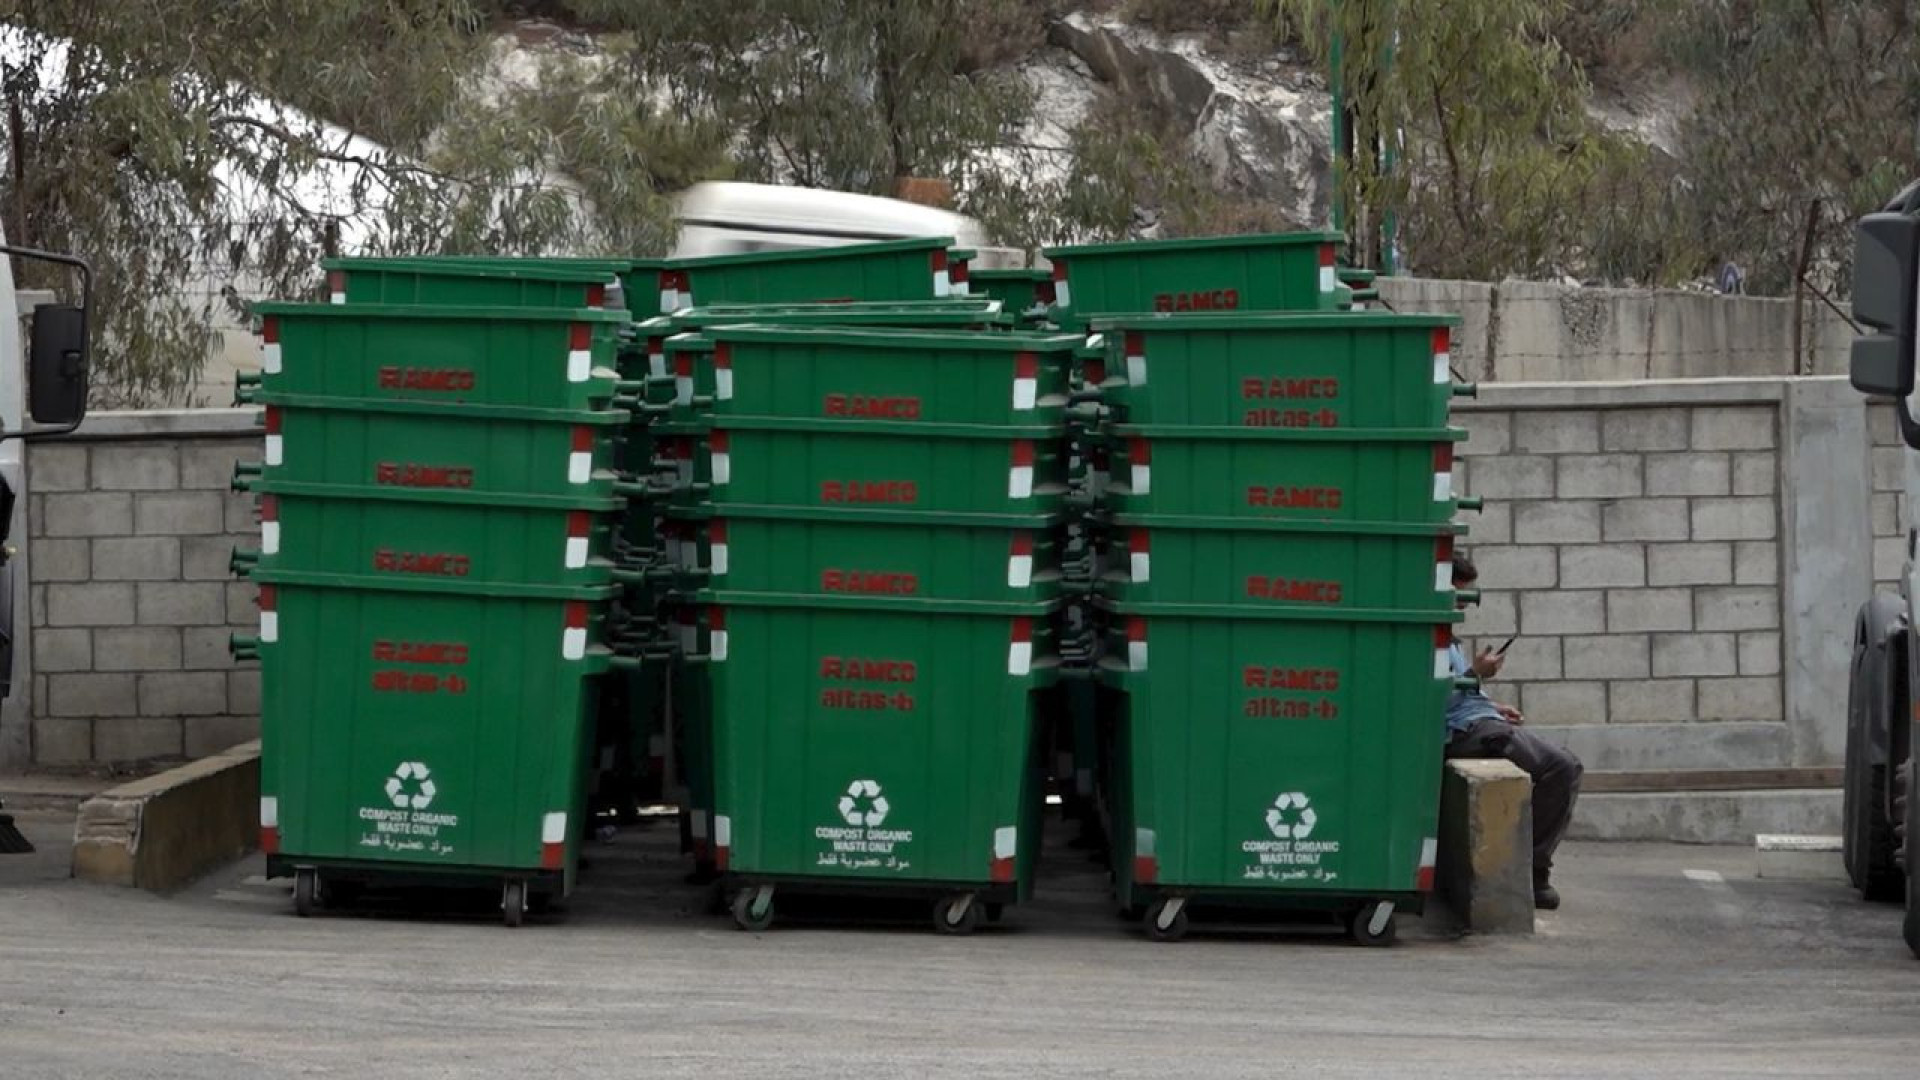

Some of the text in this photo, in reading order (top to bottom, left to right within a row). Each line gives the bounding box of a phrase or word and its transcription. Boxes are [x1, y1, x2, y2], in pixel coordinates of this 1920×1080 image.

[1243, 377, 1338, 399] RAMCO
[825, 394, 921, 419] RAMCO
[821, 480, 917, 504] RAMCO
[1247, 485, 1342, 510] RAMCO
[819, 656, 917, 682] RAMCO
[1244, 666, 1339, 691] RAMCO
[359, 808, 457, 826] COMPOST ORGANIC
[377, 821, 439, 836] WASTE ONLY
[815, 826, 912, 842] COMPOST ORGANIC
[833, 840, 895, 853] WASTE ONLY
[1242, 840, 1339, 853] COMPOST ORGANIC
[1259, 852, 1321, 865] WASTE ONLY
